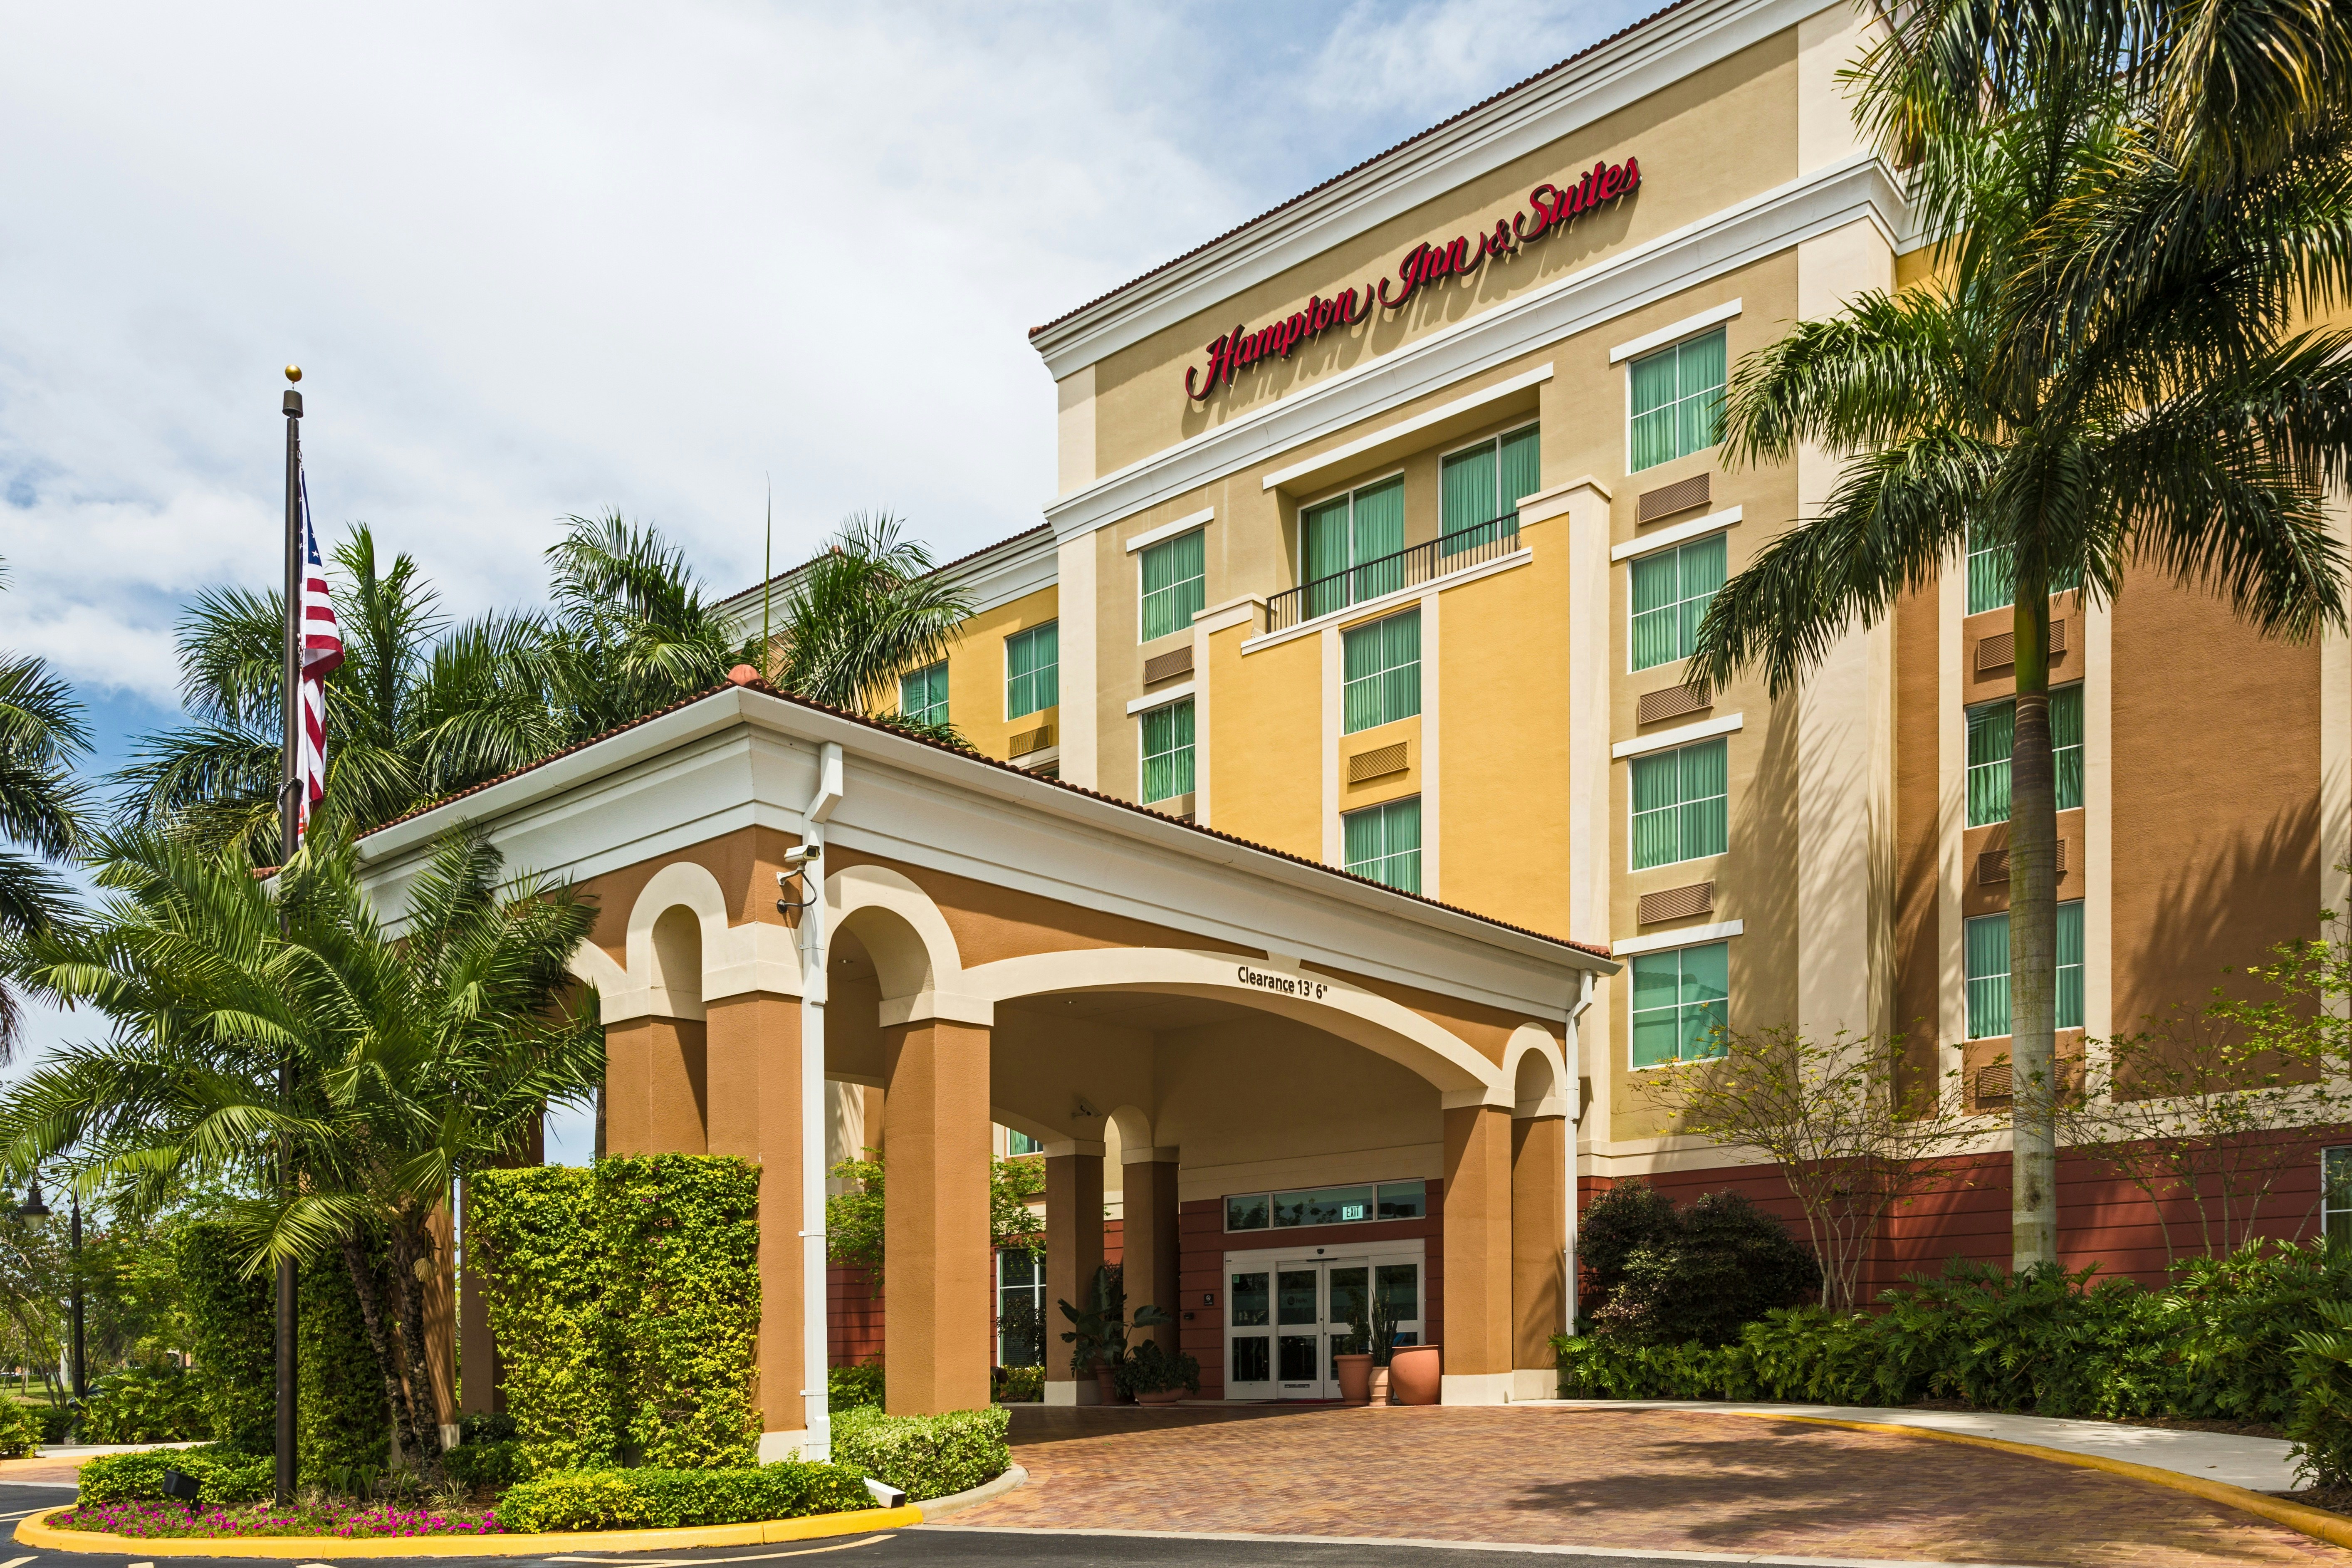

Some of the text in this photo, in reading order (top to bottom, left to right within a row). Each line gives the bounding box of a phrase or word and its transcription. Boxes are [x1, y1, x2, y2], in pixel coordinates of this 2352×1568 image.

[1185, 156, 1642, 401] Hampton Inn & Suites
[1238, 966, 1328, 999] Clearance 13' 6"
[1346, 1206, 1360, 1217] EXIT
